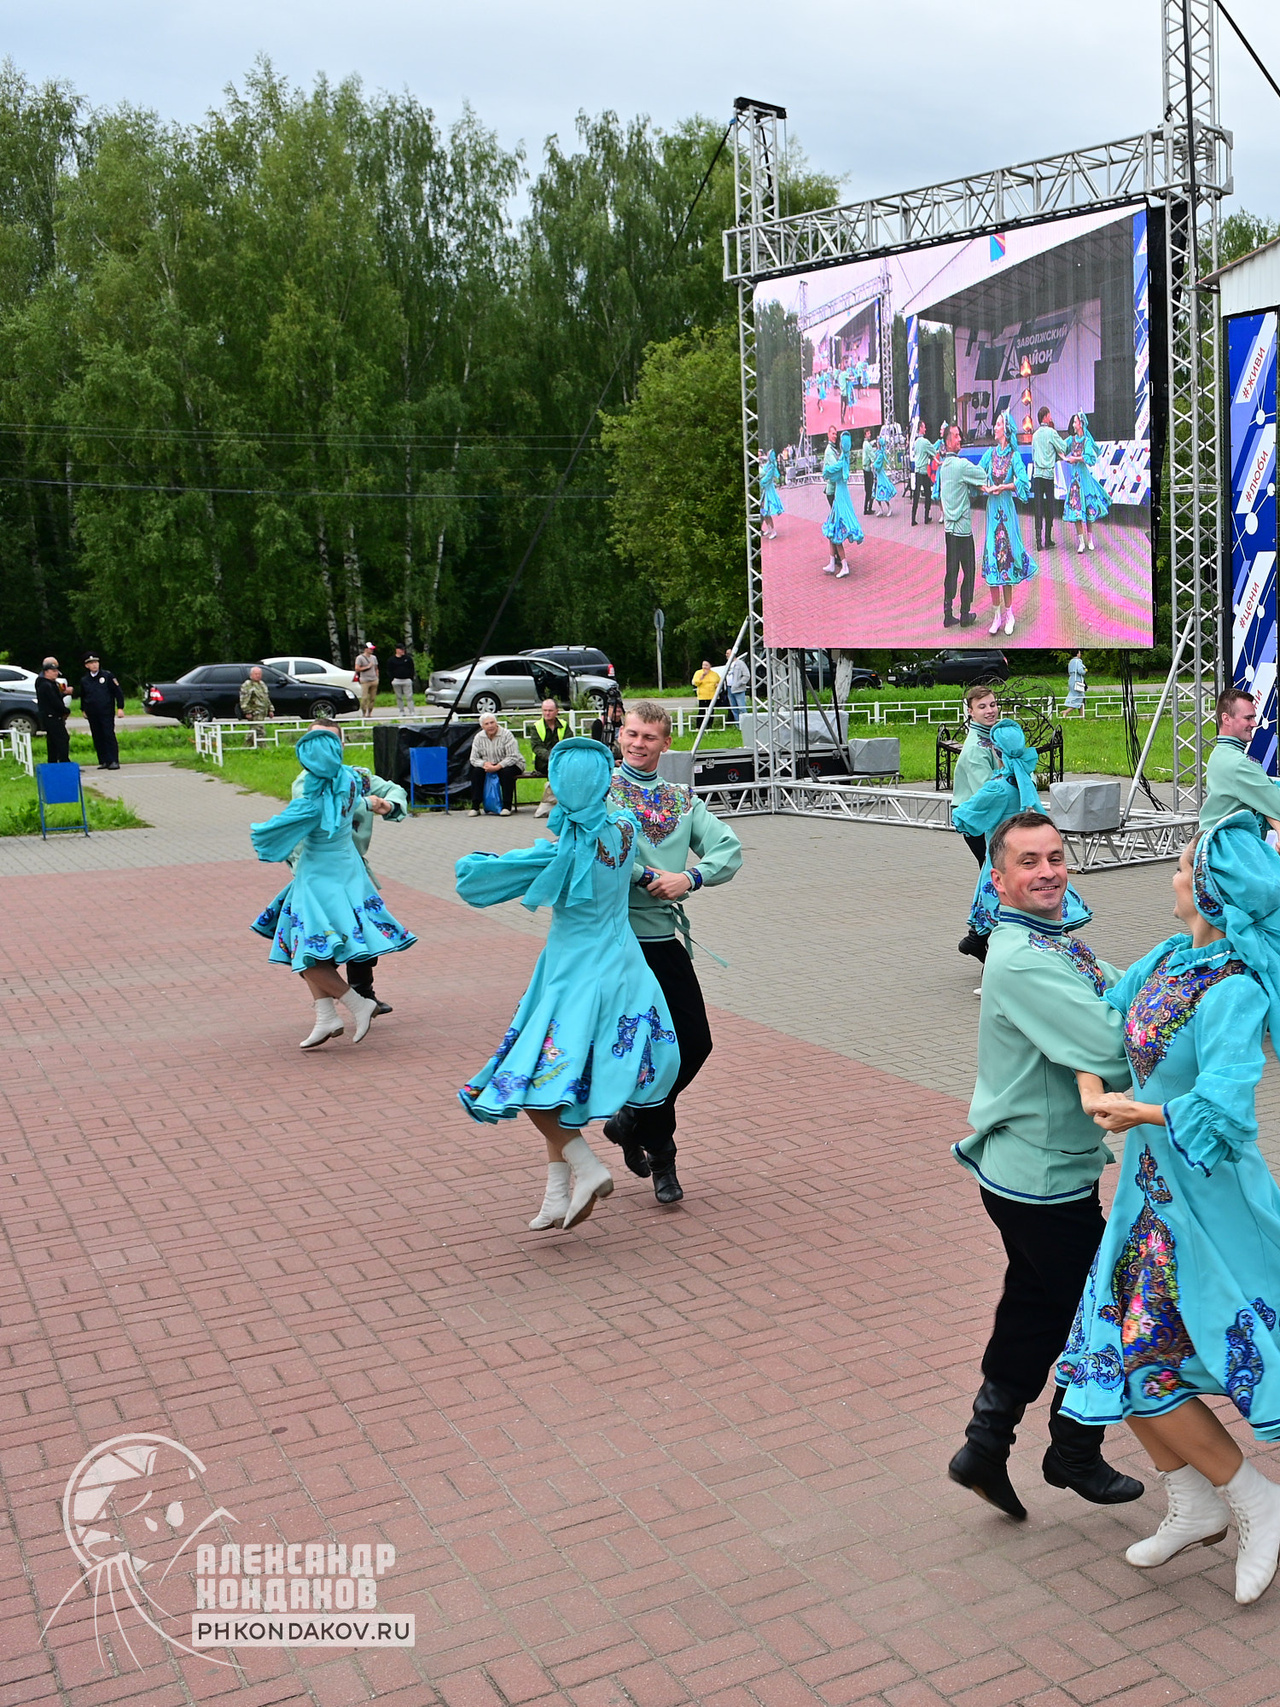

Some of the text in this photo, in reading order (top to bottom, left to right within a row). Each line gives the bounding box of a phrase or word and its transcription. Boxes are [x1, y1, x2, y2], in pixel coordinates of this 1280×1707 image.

[1016, 324, 1068, 349] ЗАВОЛЖСКИЙ
[1242, 347, 1266, 399] #живи
[1245, 450, 1269, 503] #люби
[1239, 582, 1260, 628] #цени
